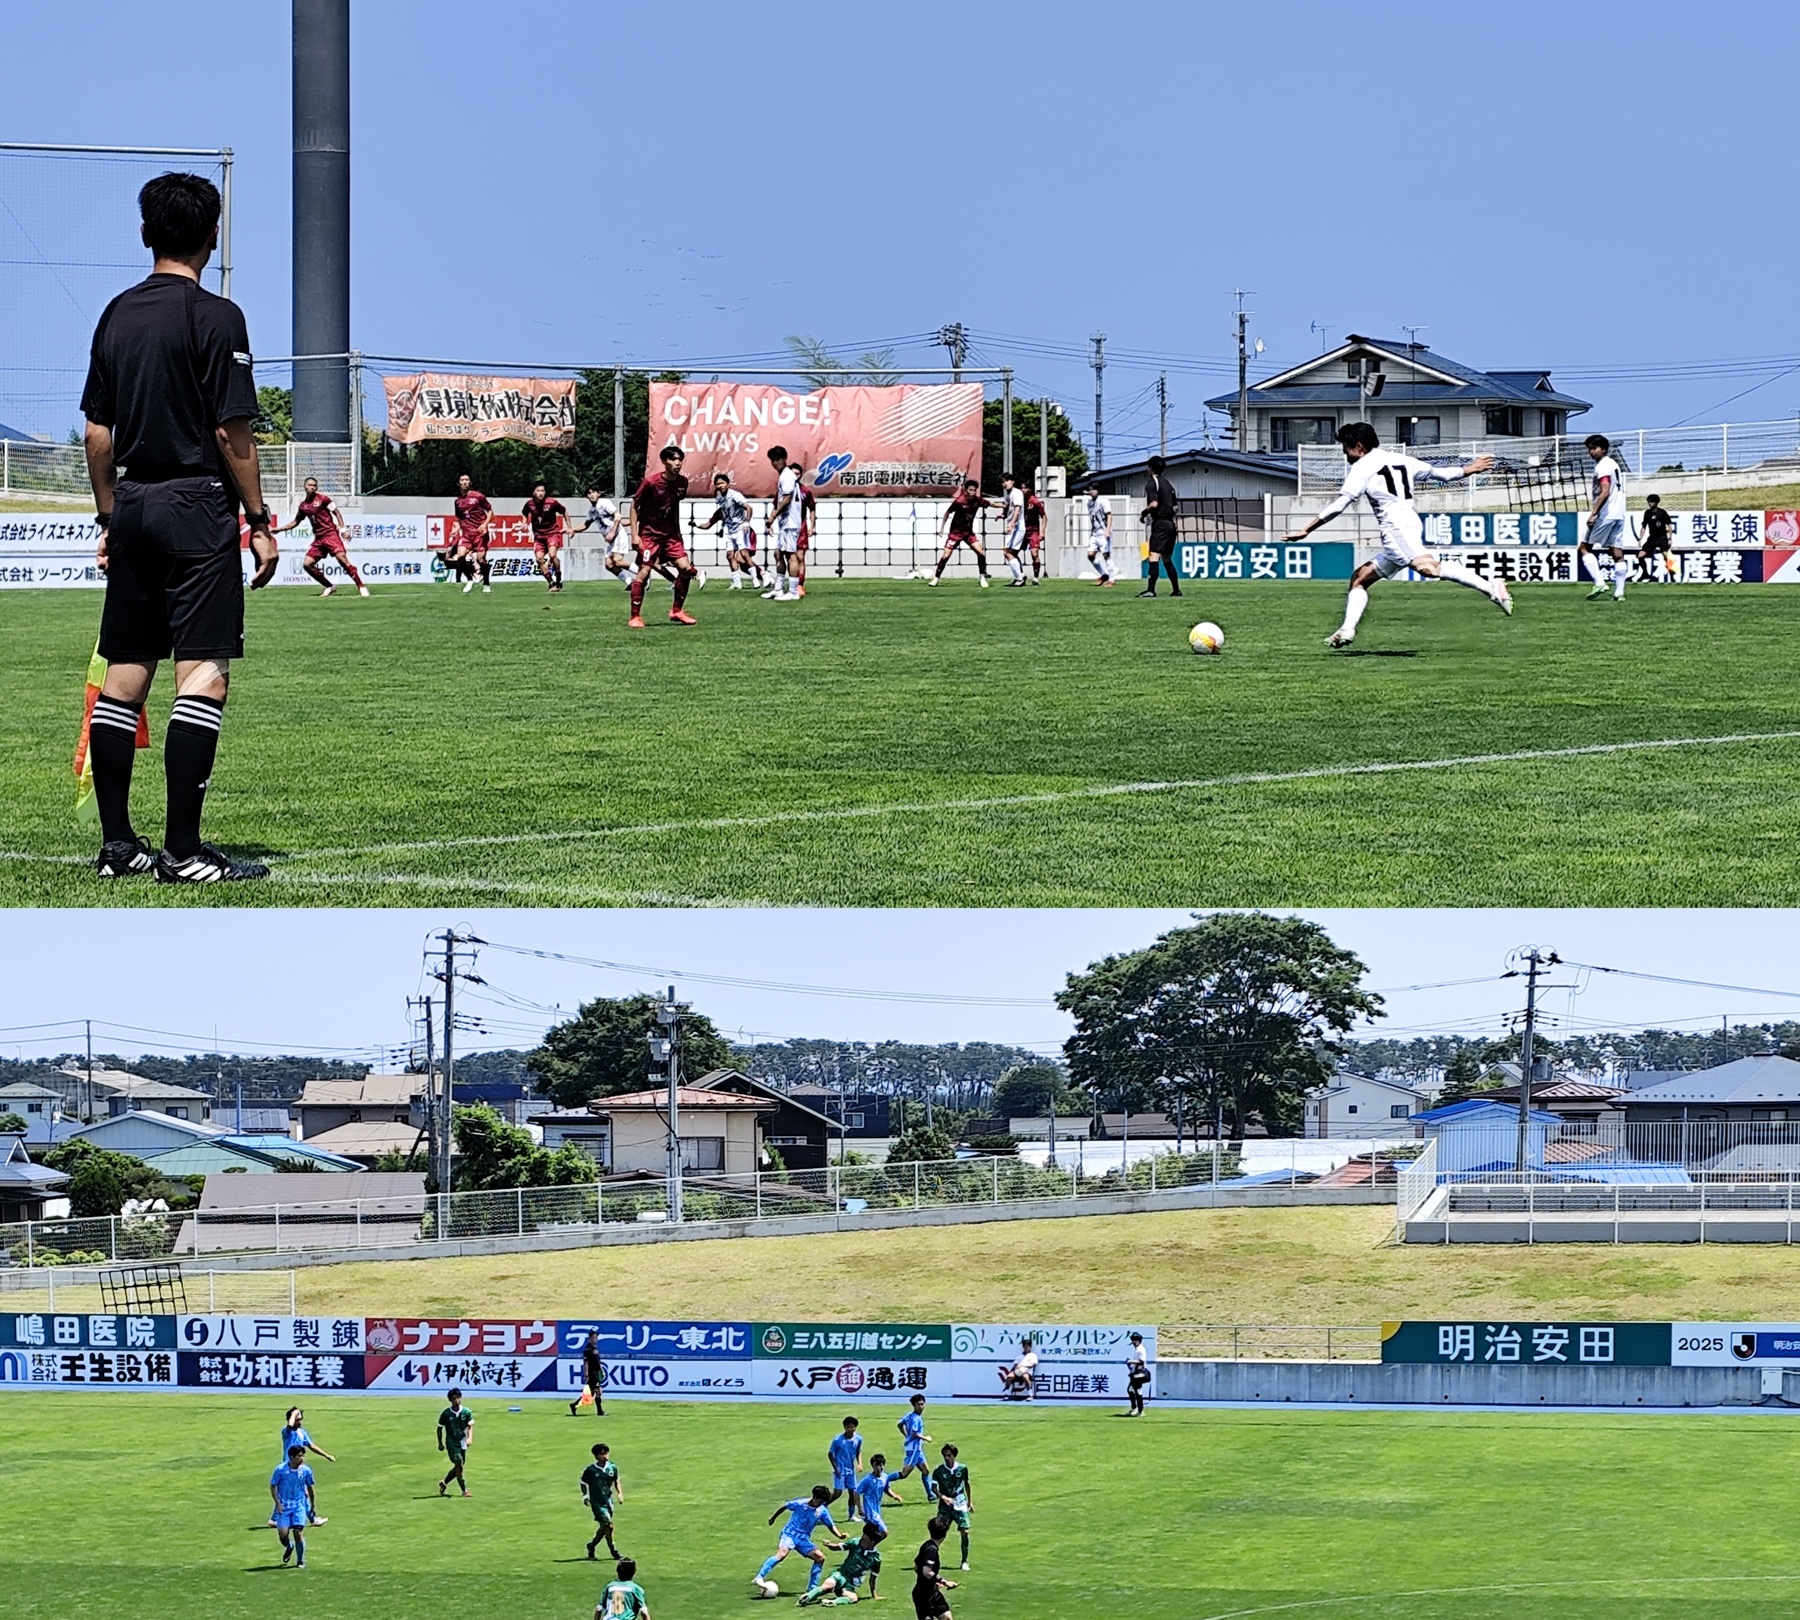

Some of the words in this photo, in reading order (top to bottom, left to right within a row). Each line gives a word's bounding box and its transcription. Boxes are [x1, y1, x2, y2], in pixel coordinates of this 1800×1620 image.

[664, 394, 832, 428] CHANGE!
[664, 431, 760, 454] ALWAYS
[1425, 513, 1557, 545] 嶋田医院
[362, 562, 391, 576] Cars
[1180, 545, 1313, 579] 明治安田
[1465, 552, 1571, 582] 壬生設備
[15, 1315, 156, 1348] 嶋田医院
[215, 1319, 361, 1349] 八戸製錬
[402, 1321, 556, 1355] ナナヨウ
[565, 1324, 746, 1352] デーリー東北
[791, 1331, 943, 1352] 三八五引越センター
[1438, 1324, 1615, 1363] 明治安田
[1678, 1338, 1724, 1351] 2025
[31, 1353, 58, 1367] 株式
[31, 1367, 58, 1382] 会社
[60, 1353, 171, 1384] 壬生設備
[225, 1355, 345, 1387] 功和産業
[431, 1357, 524, 1387] 伊藤商事
[1034, 1374, 1110, 1393] 吉田産業
